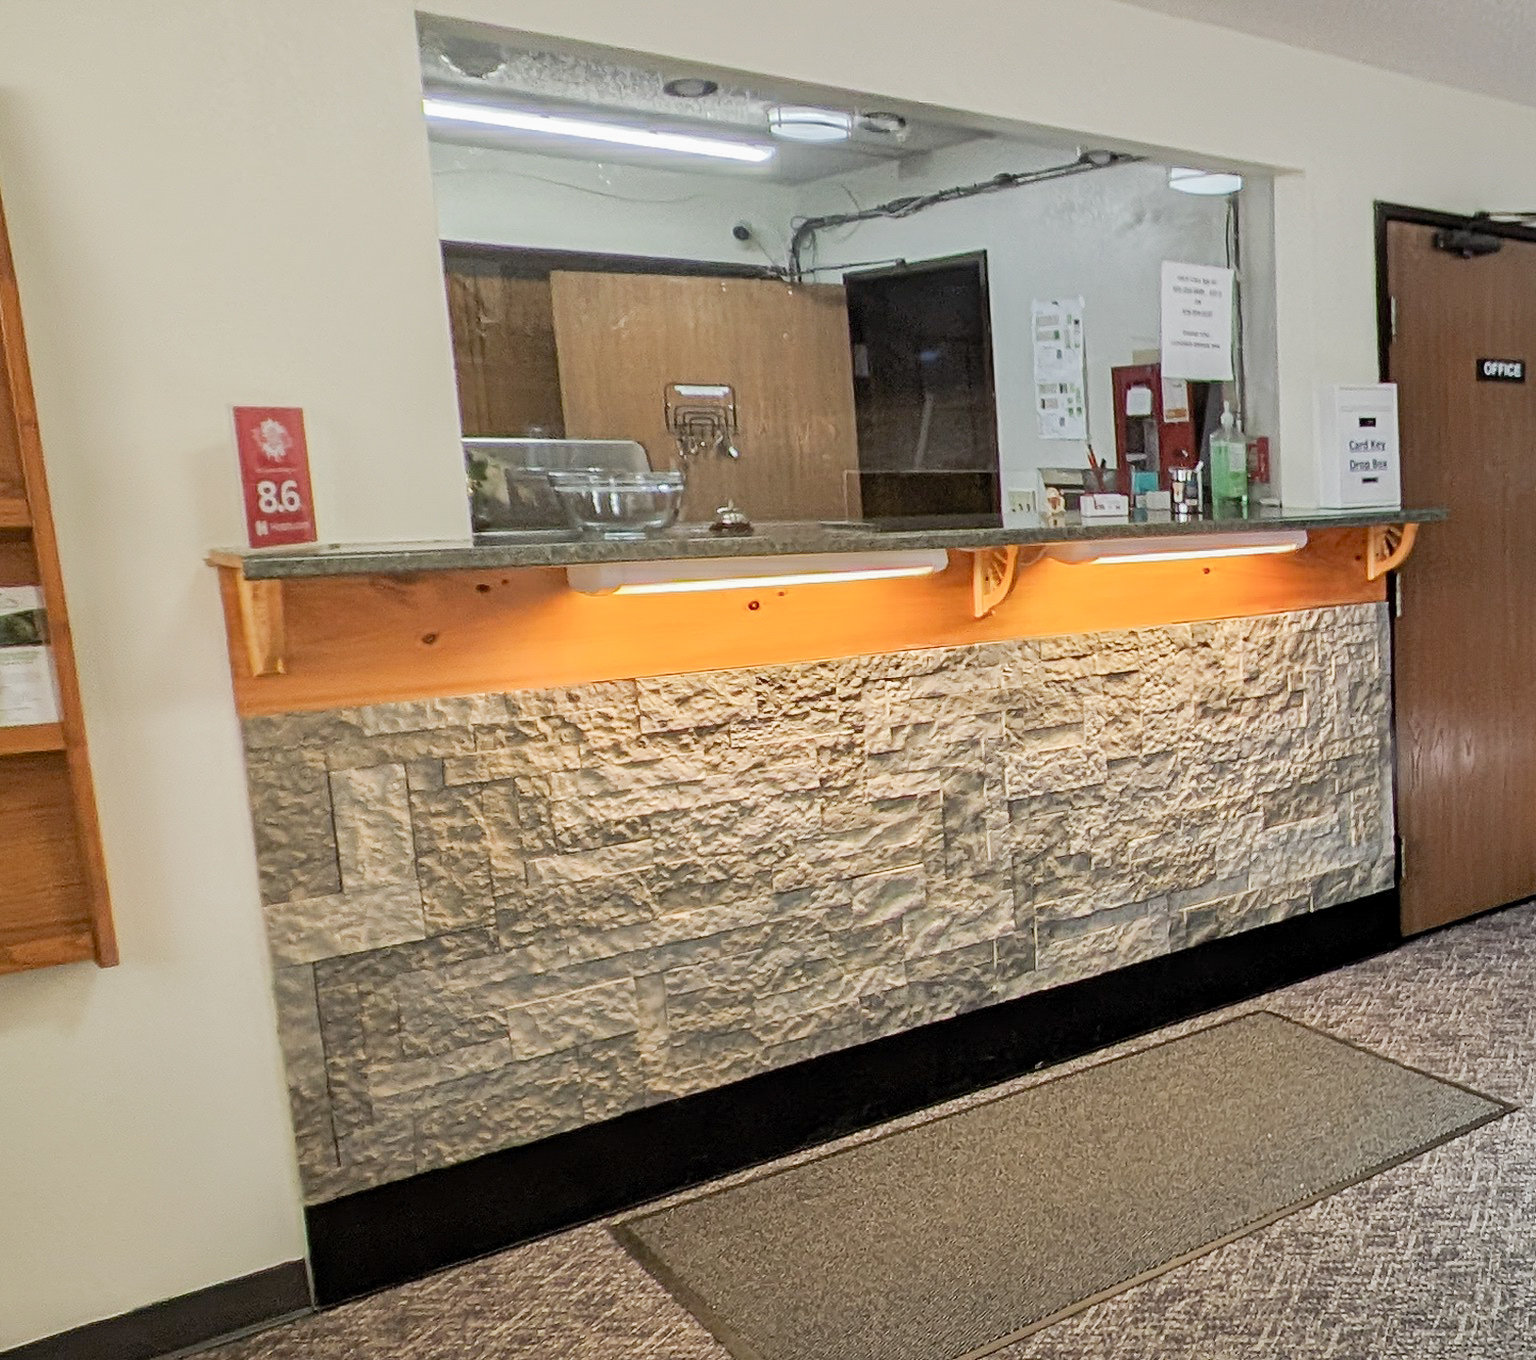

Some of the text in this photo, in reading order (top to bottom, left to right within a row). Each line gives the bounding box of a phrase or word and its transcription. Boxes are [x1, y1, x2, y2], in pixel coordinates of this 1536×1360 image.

[1483, 361, 1521, 378] OFFICE
[1349, 441, 1386, 451] Card Key
[1350, 459, 1387, 471] Drop Box
[258, 480, 300, 513] 8.6
